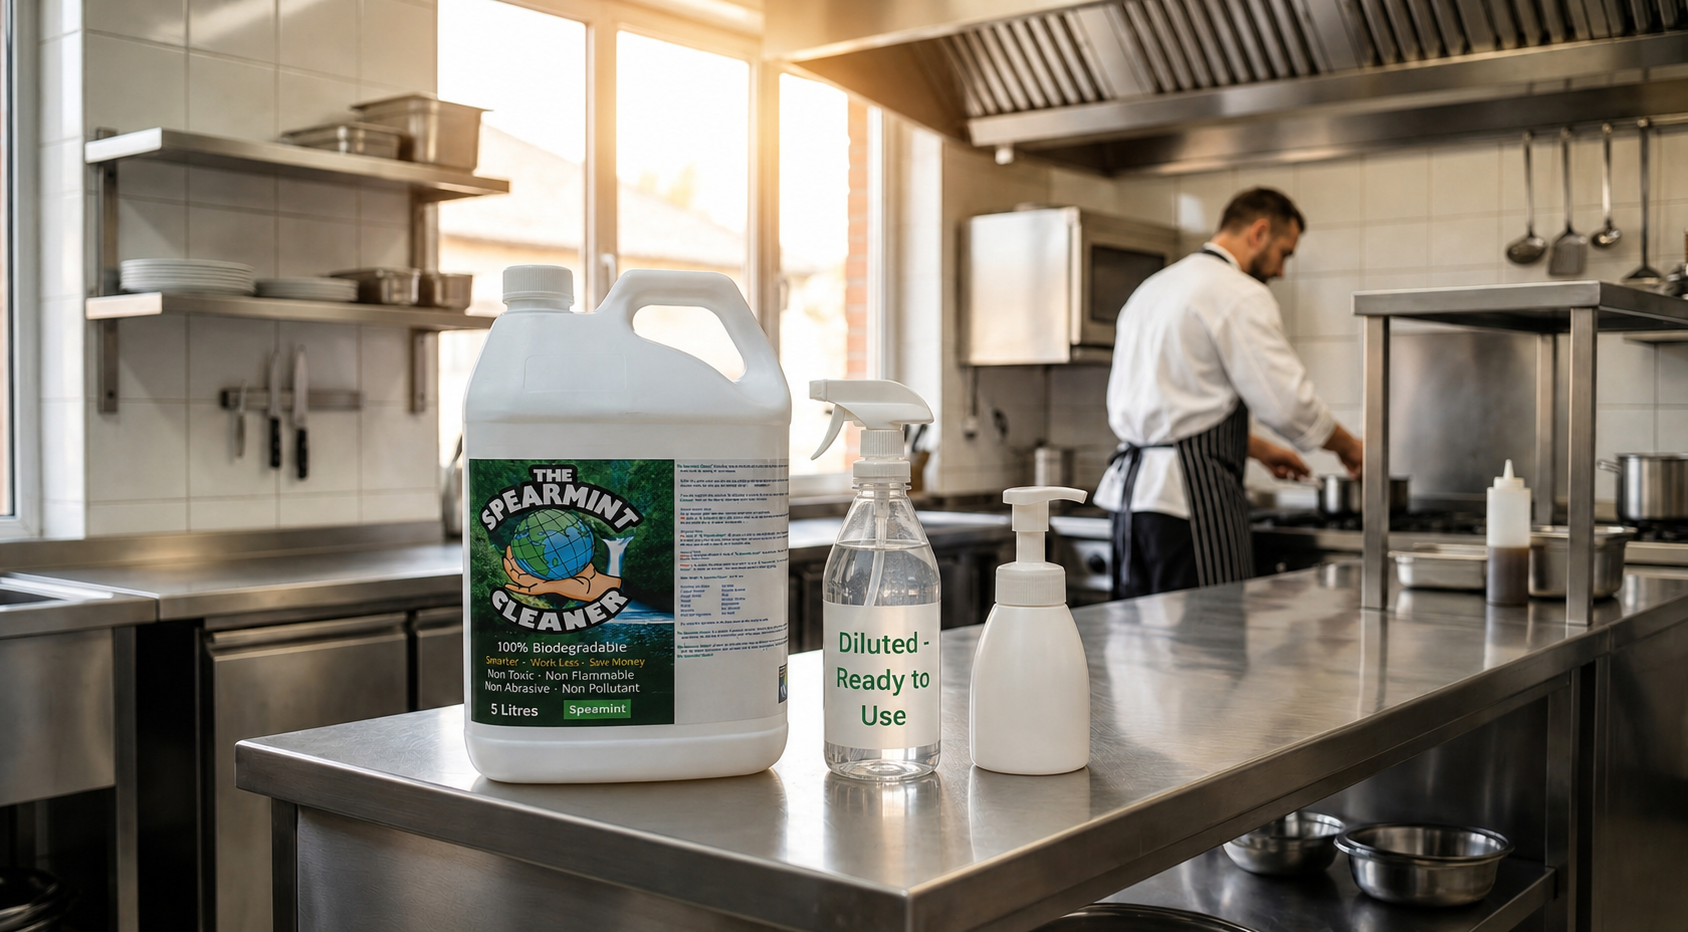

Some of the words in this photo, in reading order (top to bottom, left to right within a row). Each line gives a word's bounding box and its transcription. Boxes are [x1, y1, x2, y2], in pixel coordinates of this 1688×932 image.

[533, 469, 573, 482] THE
[481, 484, 639, 531] SPEARMINT
[492, 590, 628, 632] CLEANER
[497, 641, 529, 653] 100%
[532, 641, 628, 656] Biodegradable
[839, 631, 918, 654] Diluted
[485, 655, 519, 667] Smarter
[530, 658, 557, 667] Work
[558, 658, 580, 667] Less
[611, 658, 646, 668] Money
[487, 668, 506, 679] Non
[508, 669, 535, 680] Toxic
[545, 670, 569, 681] Non
[572, 669, 635, 681] Flammable
[836, 667, 905, 696] Ready
[911, 670, 930, 689] to
[484, 681, 502, 692] Non
[504, 682, 551, 694] Abrasive
[562, 683, 586, 694] Non
[589, 682, 641, 694] Pollutant
[490, 703, 498, 715] 5
[501, 704, 539, 717] Litres
[861, 705, 906, 726] Use
